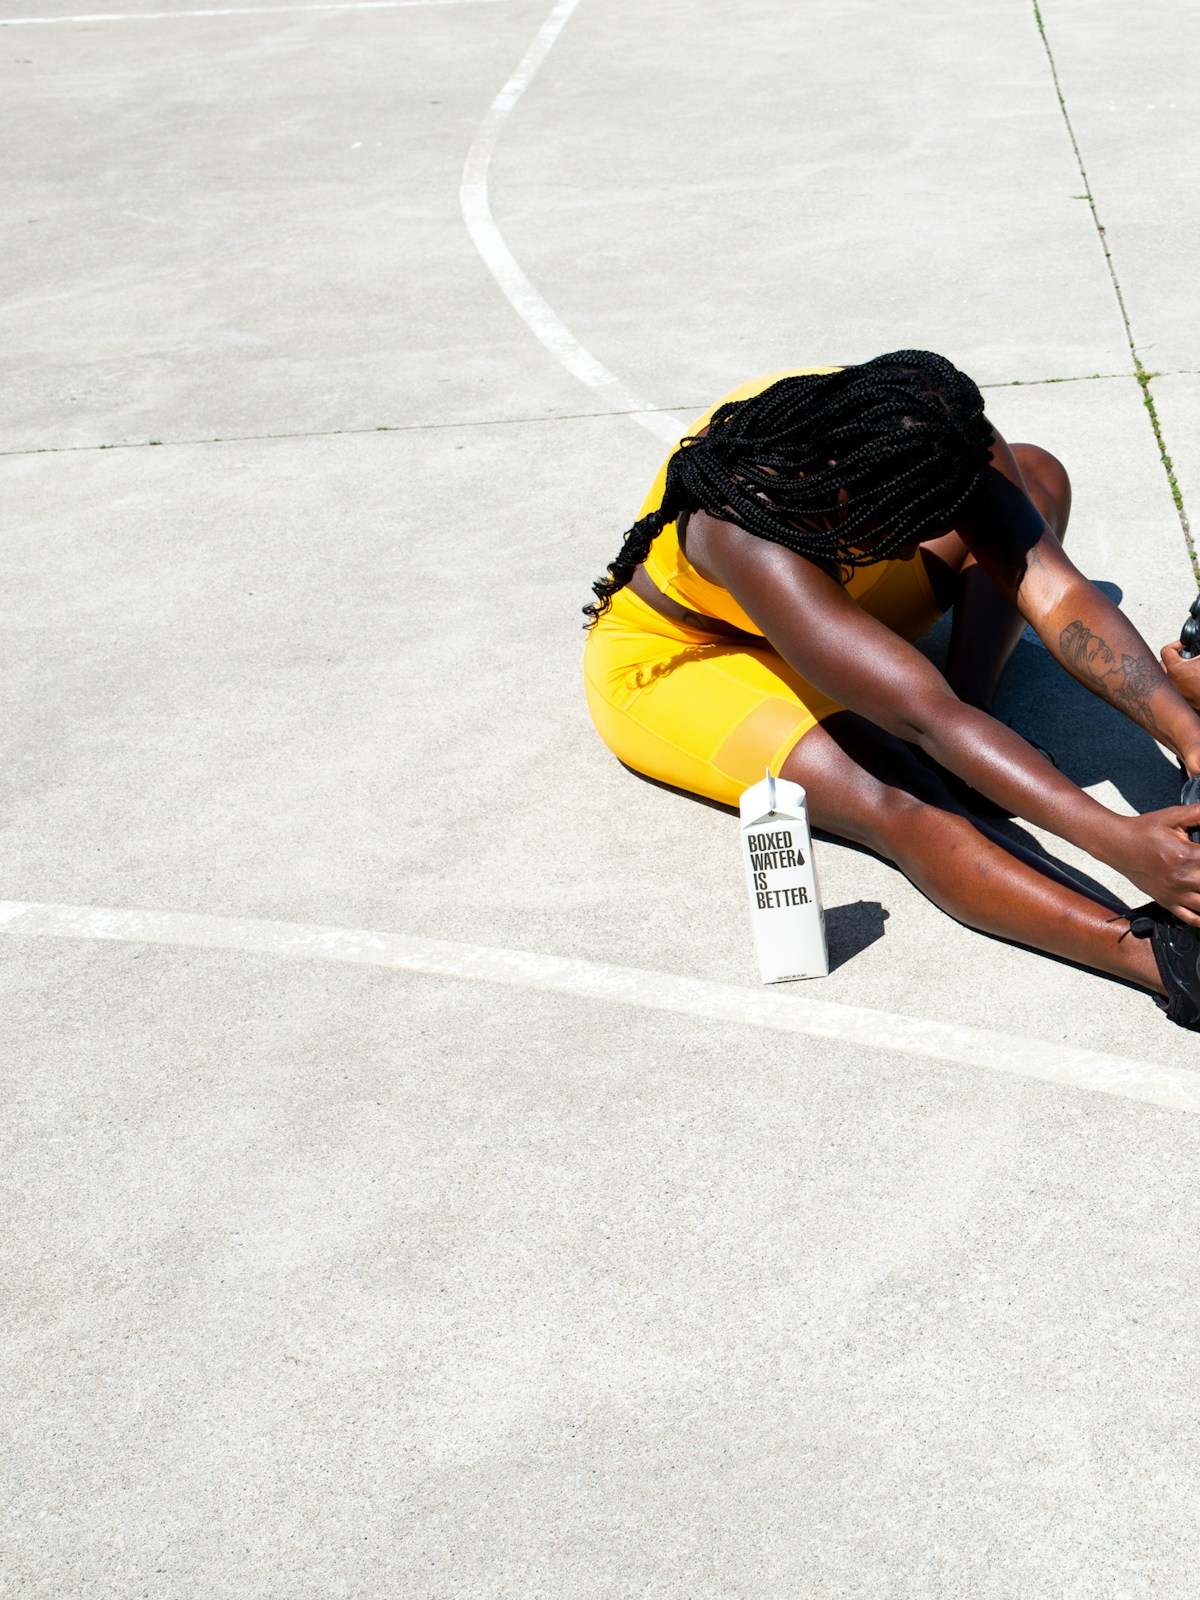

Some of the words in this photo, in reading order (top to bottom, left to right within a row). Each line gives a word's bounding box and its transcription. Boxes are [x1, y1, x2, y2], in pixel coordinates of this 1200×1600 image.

[747, 831, 793, 853] BOXED
[750, 849, 797, 872] WATER
[753, 871, 768, 891] IS
[756, 886, 812, 910] BETTER.
